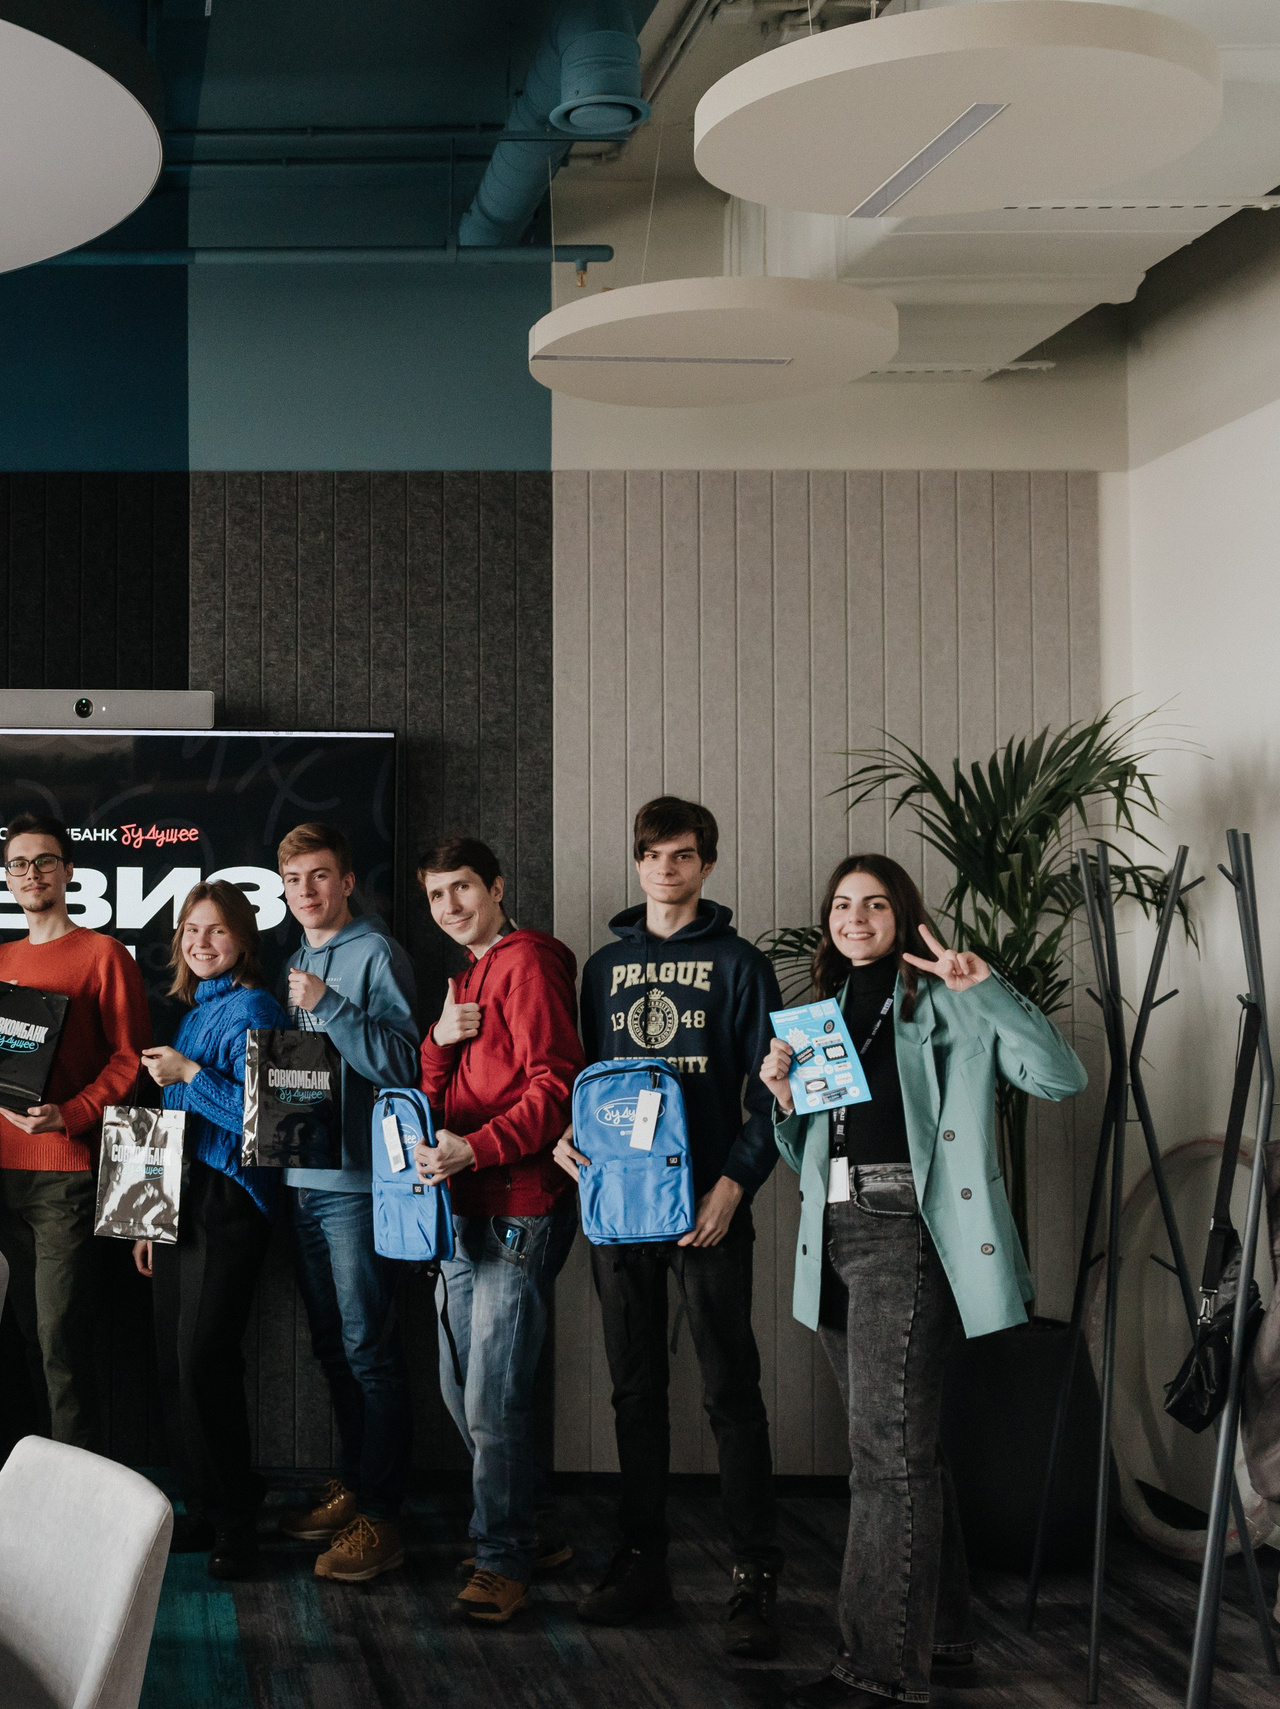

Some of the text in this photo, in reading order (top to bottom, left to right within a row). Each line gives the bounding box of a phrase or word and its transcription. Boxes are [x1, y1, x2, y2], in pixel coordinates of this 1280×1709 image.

[610, 961, 714, 997] PRAGUE
[611, 1012, 625, 1032] 13
[681, 1010, 706, 1029] 48
[268, 1069, 331, 1090] СОВКОМБАНК
